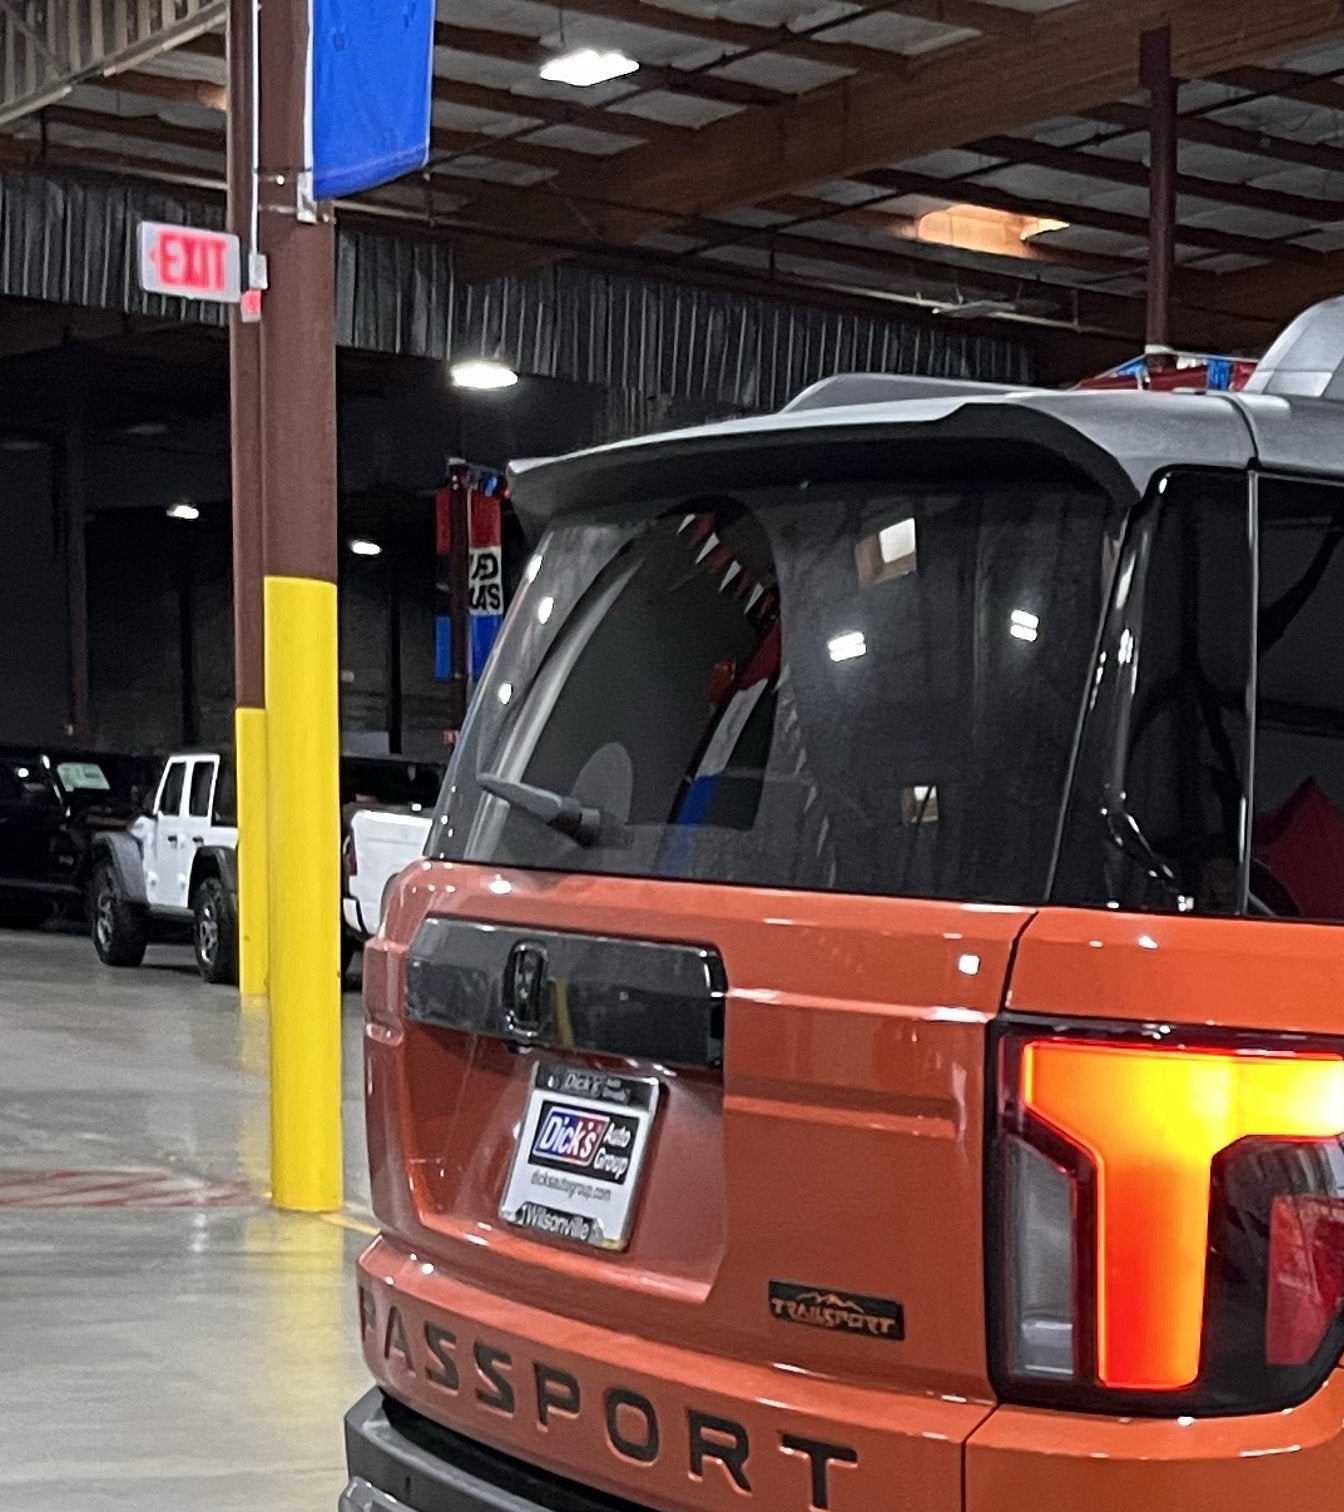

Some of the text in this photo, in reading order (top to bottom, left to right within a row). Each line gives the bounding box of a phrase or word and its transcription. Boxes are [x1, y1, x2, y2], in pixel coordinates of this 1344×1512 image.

[157, 230, 227, 292] EXIT
[539, 1115, 597, 1158] Dick's
[603, 1122, 632, 1148] Auto
[594, 1148, 629, 1179] Group
[525, 1203, 590, 1241] Wilsonville
[771, 1298, 896, 1335] TRAILSPORT
